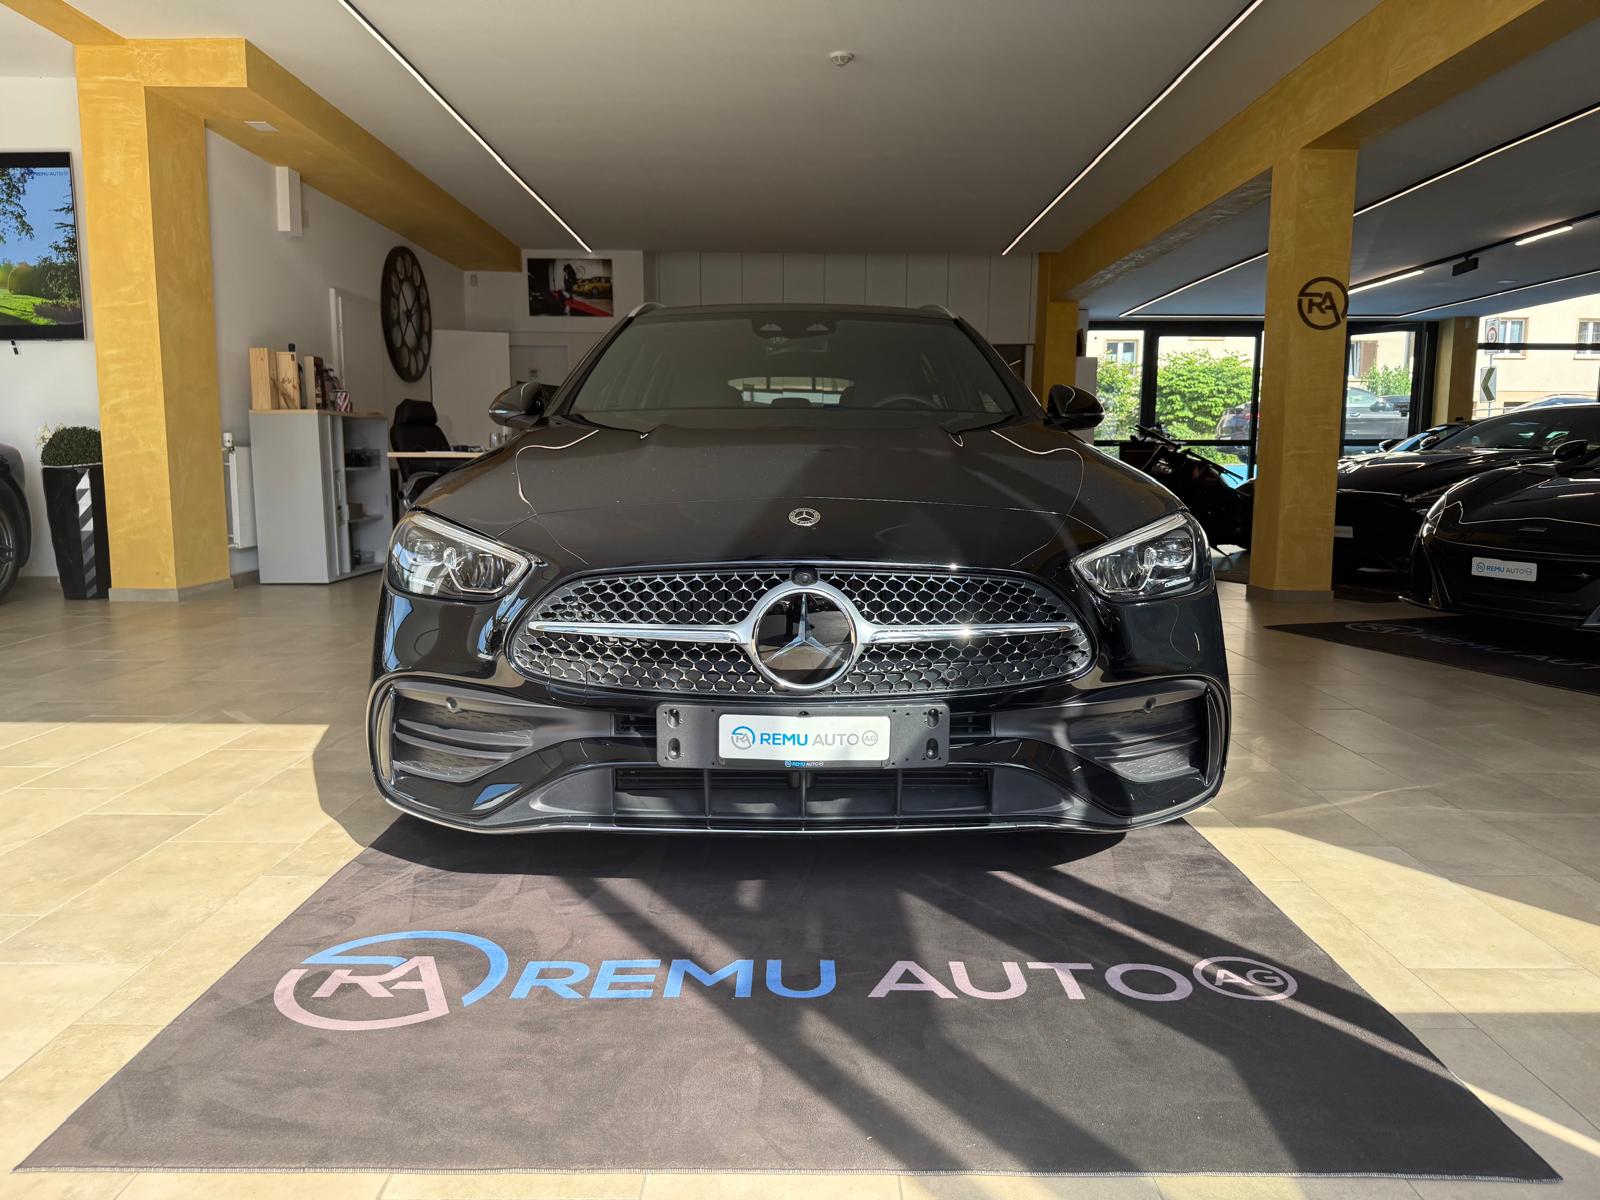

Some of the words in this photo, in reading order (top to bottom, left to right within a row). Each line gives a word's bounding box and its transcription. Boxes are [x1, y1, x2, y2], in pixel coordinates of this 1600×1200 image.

[1486, 565, 1505, 573] REMU
[1506, 567, 1525, 575] AUTO
[760, 733, 808, 746] REMU
[812, 733, 859, 746] AUTO
[509, 959, 836, 999] REMU
[867, 960, 1194, 1002] AUTO
[1214, 968, 1285, 987] AG
